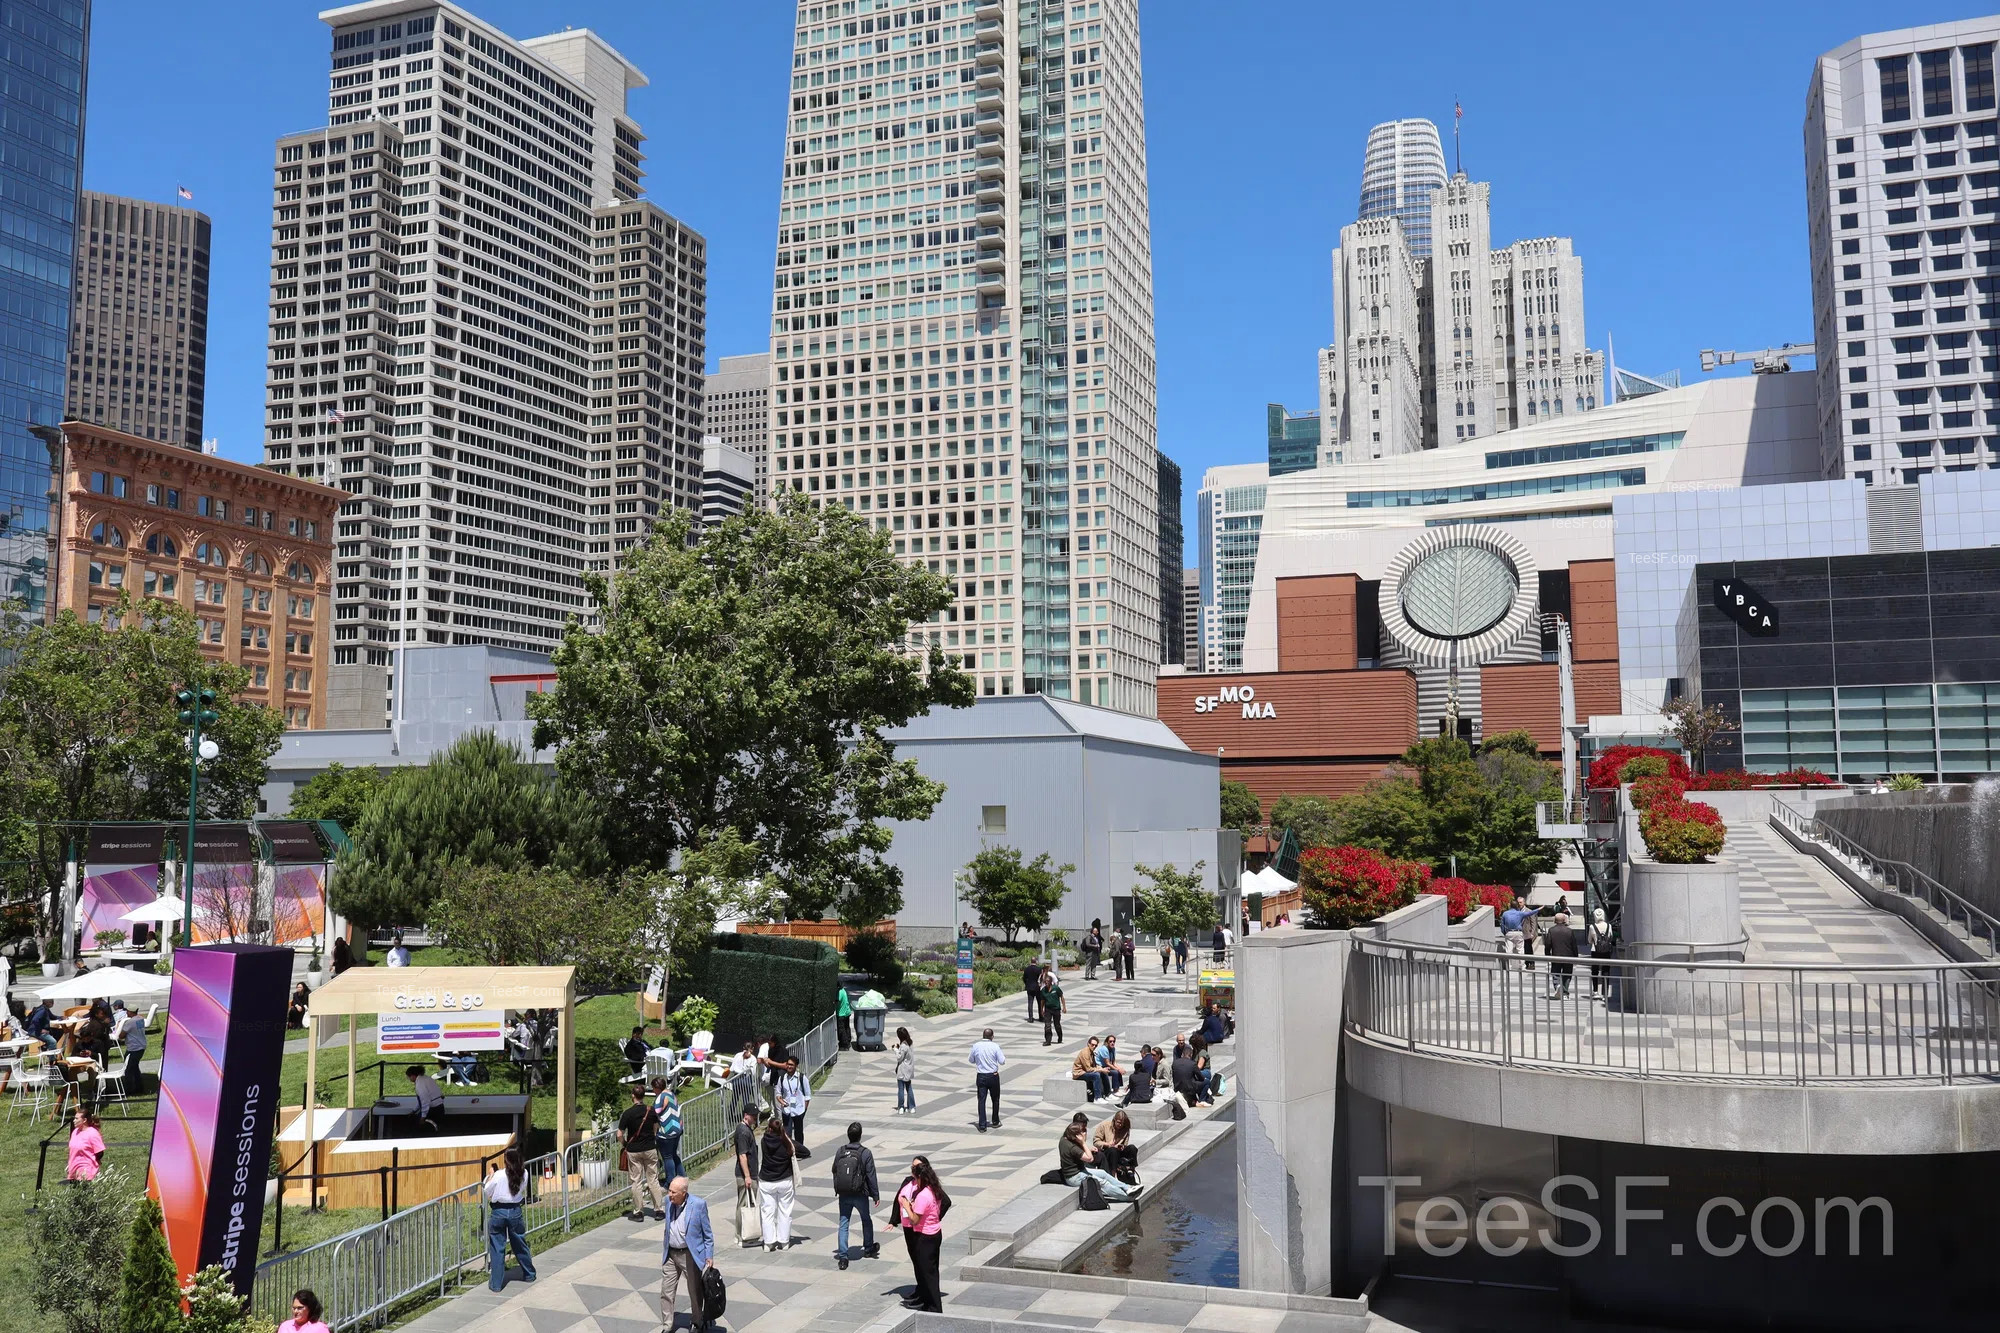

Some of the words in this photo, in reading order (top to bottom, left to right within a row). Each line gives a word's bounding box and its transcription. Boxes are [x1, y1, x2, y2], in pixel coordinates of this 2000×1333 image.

[394, 992, 437, 1009] Grab
[442, 992, 456, 1008] &
[461, 993, 484, 1011] go
[233, 1084, 260, 1196] sessions
[222, 1201, 245, 1271] stripe
